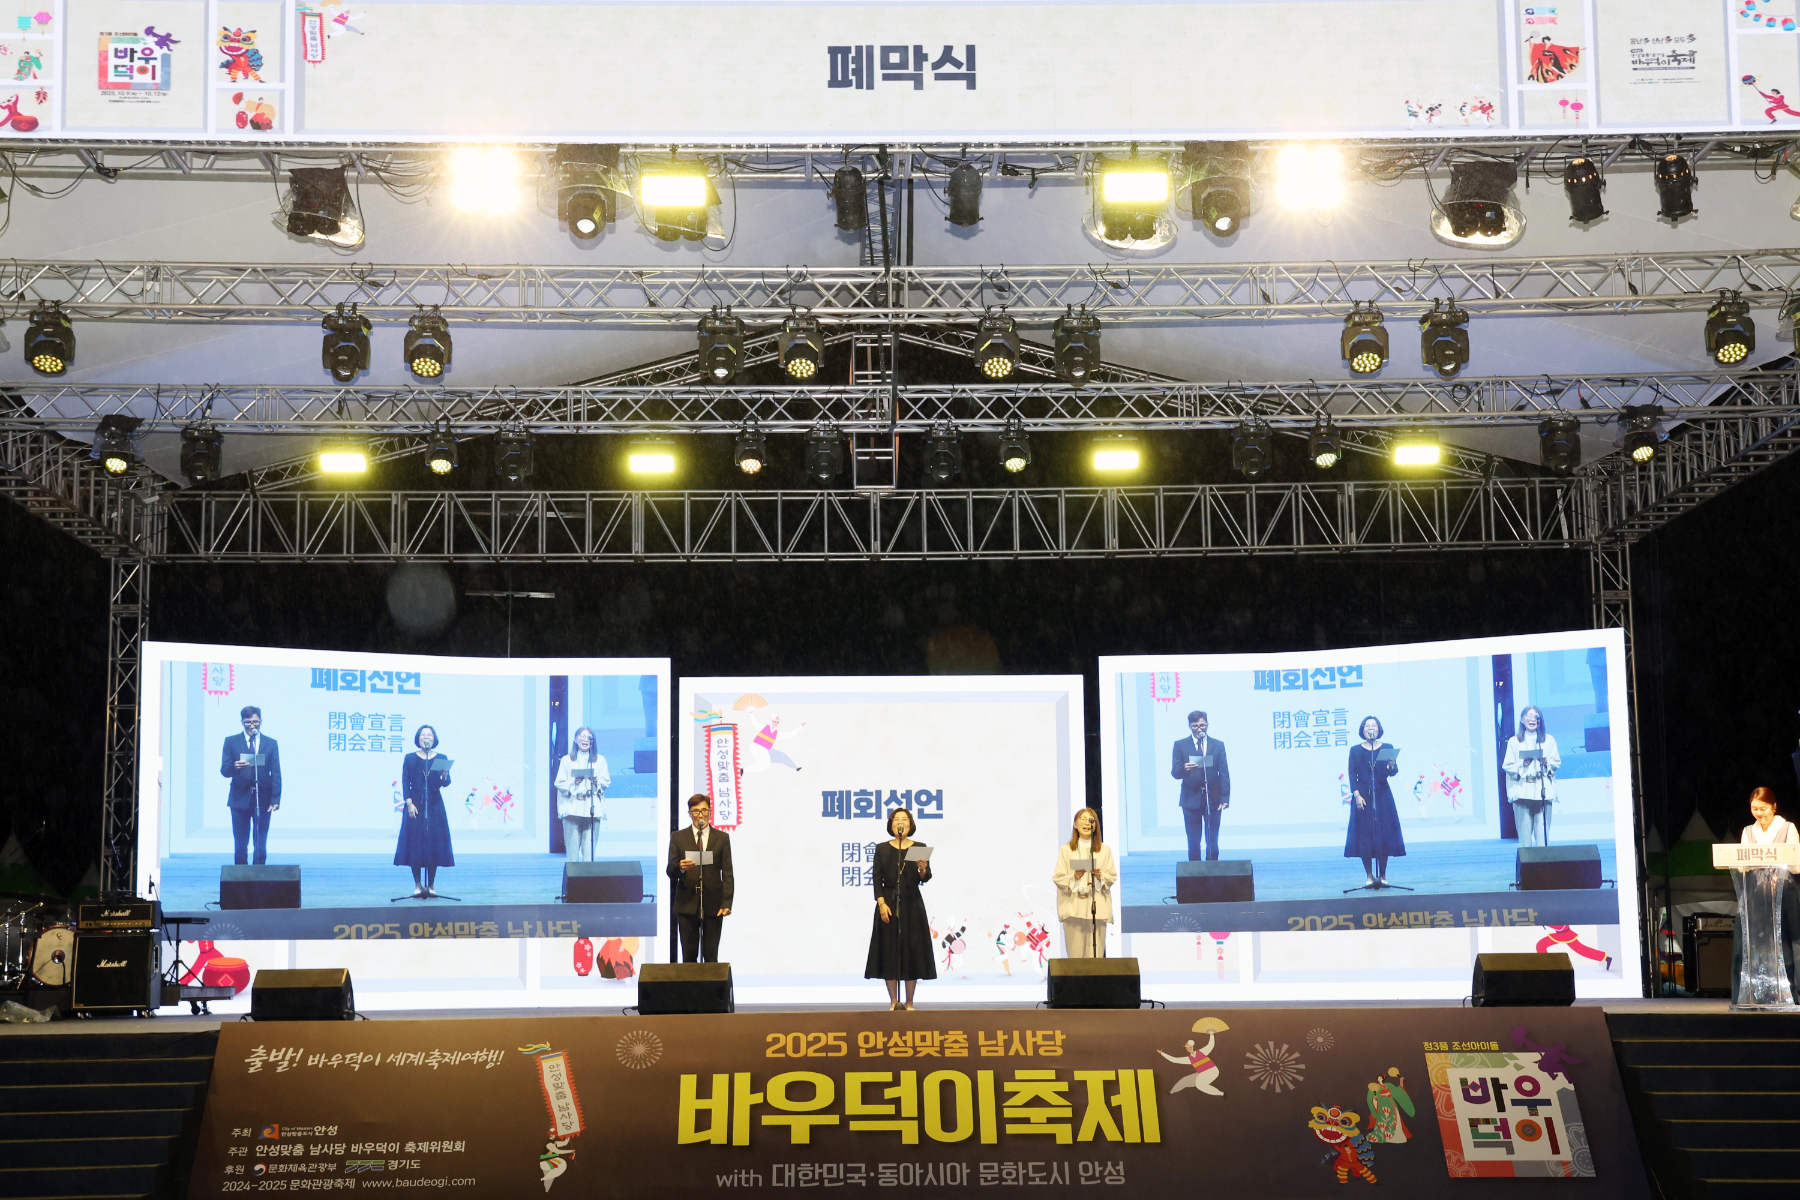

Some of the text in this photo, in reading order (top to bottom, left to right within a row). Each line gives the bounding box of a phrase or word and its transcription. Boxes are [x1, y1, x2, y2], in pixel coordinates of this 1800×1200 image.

[114, 47, 157, 64] 바우
[114, 65, 156, 80] 덕이
[828, 44, 976, 90] 폐막식
[212, 663, 225, 686] 사당
[310, 667, 421, 695] 폐회선언
[1159, 672, 1171, 694] 사당
[1253, 664, 1363, 692] 폐회선언
[328, 711, 406, 732] 閉會宣言
[1273, 708, 1350, 729] 閉會宣言
[328, 733, 406, 753] 閉会宣言
[1273, 729, 1350, 750] 閉会宣言
[717, 738, 732, 820] 안성맞춤 남사당
[822, 789, 943, 820] 폐회선언
[1736, 848, 1777, 861] 폐막식
[97, 959, 128, 968] Marshall
[765, 1030, 1066, 1058] 2025 안성맞춤 남사당
[1423, 1041, 1499, 1051] 정3품 조선아이들
[245, 1045, 304, 1073] 출발!
[307, 1052, 381, 1071] 바우덕이
[549, 1063, 574, 1130] 안성맞춤 남사당
[1459, 1075, 1552, 1116] 바우
[677, 1068, 1161, 1146] 바우덕이축제
[231, 1128, 252, 1137] 주최
[314, 1125, 338, 1136] 안성
[1468, 1117, 1560, 1155] 덕이
[228, 1141, 466, 1156] 주관 안성맞춤 남사당 바우덕이 축제위원회
[224, 1163, 337, 1175] 후원 문화체육관광부
[388, 1159, 421, 1170] 경기도
[715, 1161, 1126, 1188] with 대한민국·동아시아 문화도시 안성
[222, 1177, 476, 1191] 2024-2025 문화관광축제 www.baudeogi.com
